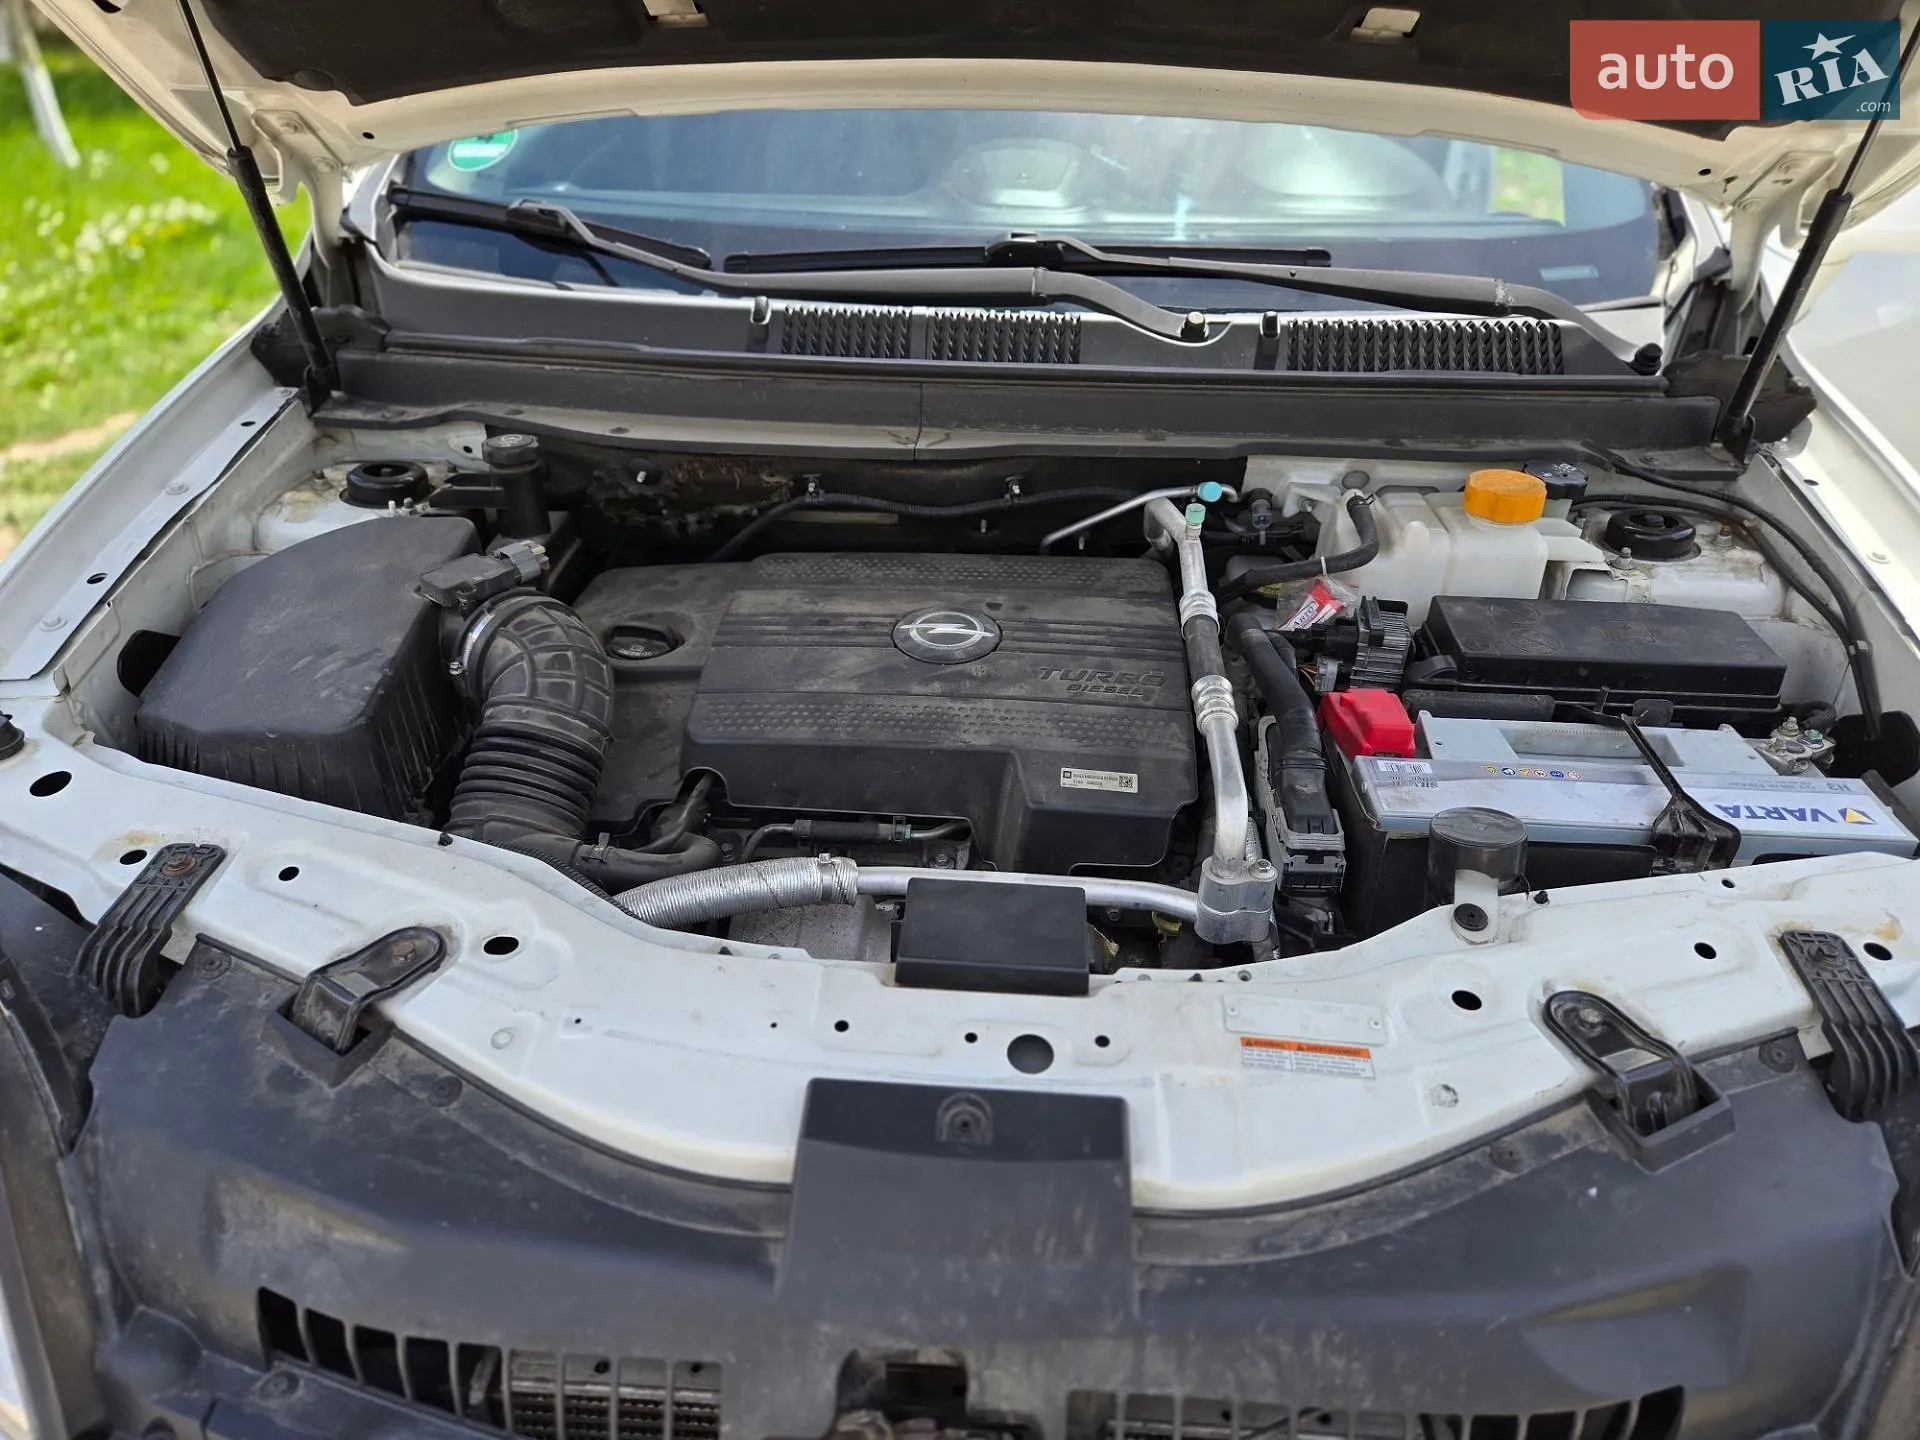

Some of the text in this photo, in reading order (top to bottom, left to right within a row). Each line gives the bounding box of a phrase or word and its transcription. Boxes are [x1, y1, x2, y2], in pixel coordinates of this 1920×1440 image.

[1040, 668, 1167, 688] TURBO
[1066, 683, 1143, 696] DIESEL
[1714, 804, 1838, 822] VARTA
